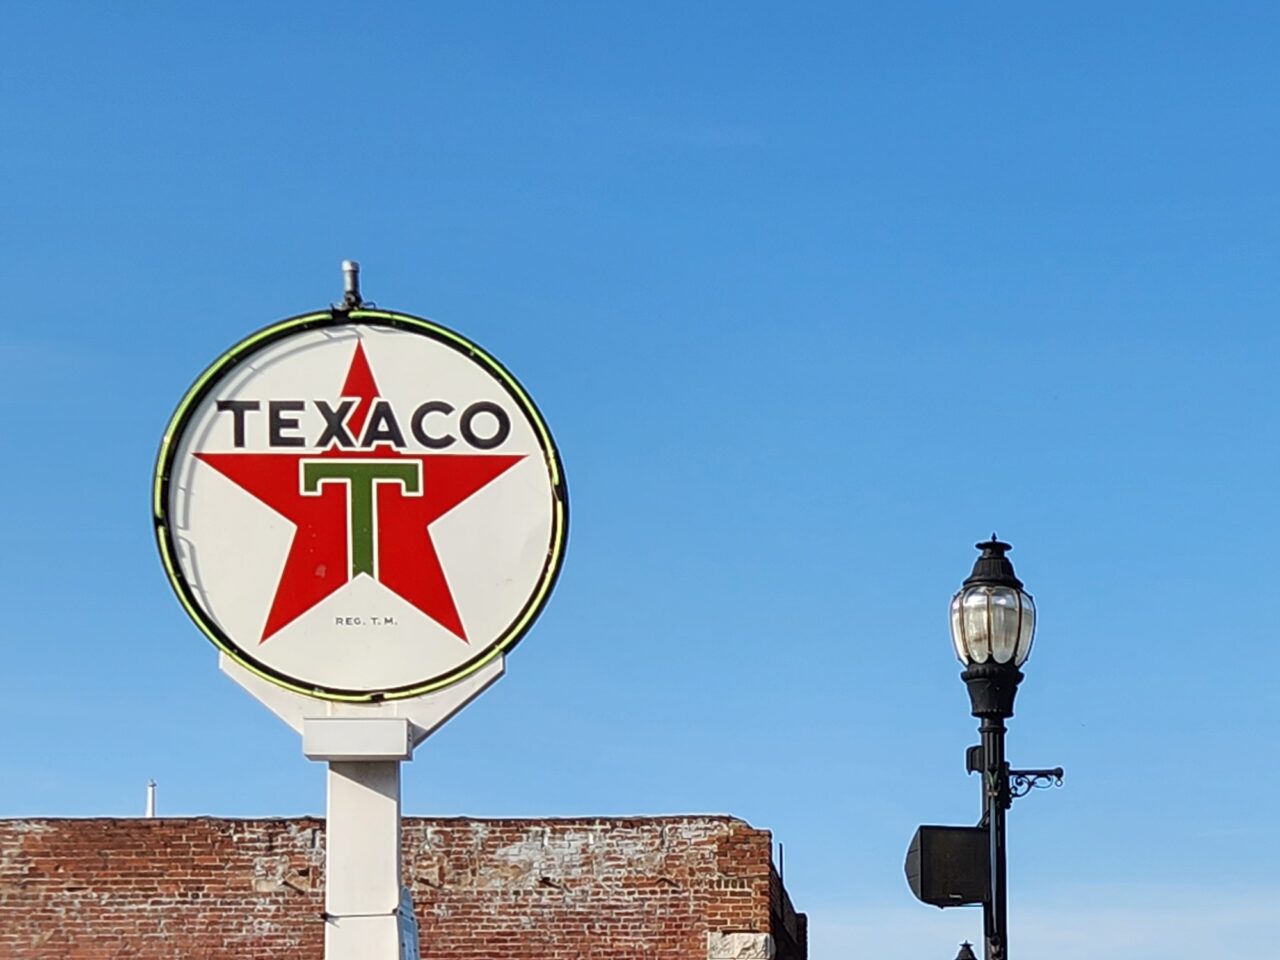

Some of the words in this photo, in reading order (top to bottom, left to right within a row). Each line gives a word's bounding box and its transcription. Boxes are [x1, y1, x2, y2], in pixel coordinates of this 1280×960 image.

[217, 400, 512, 450] TEXACO
[303, 462, 419, 580] T
[335, 616, 366, 626] REG.
